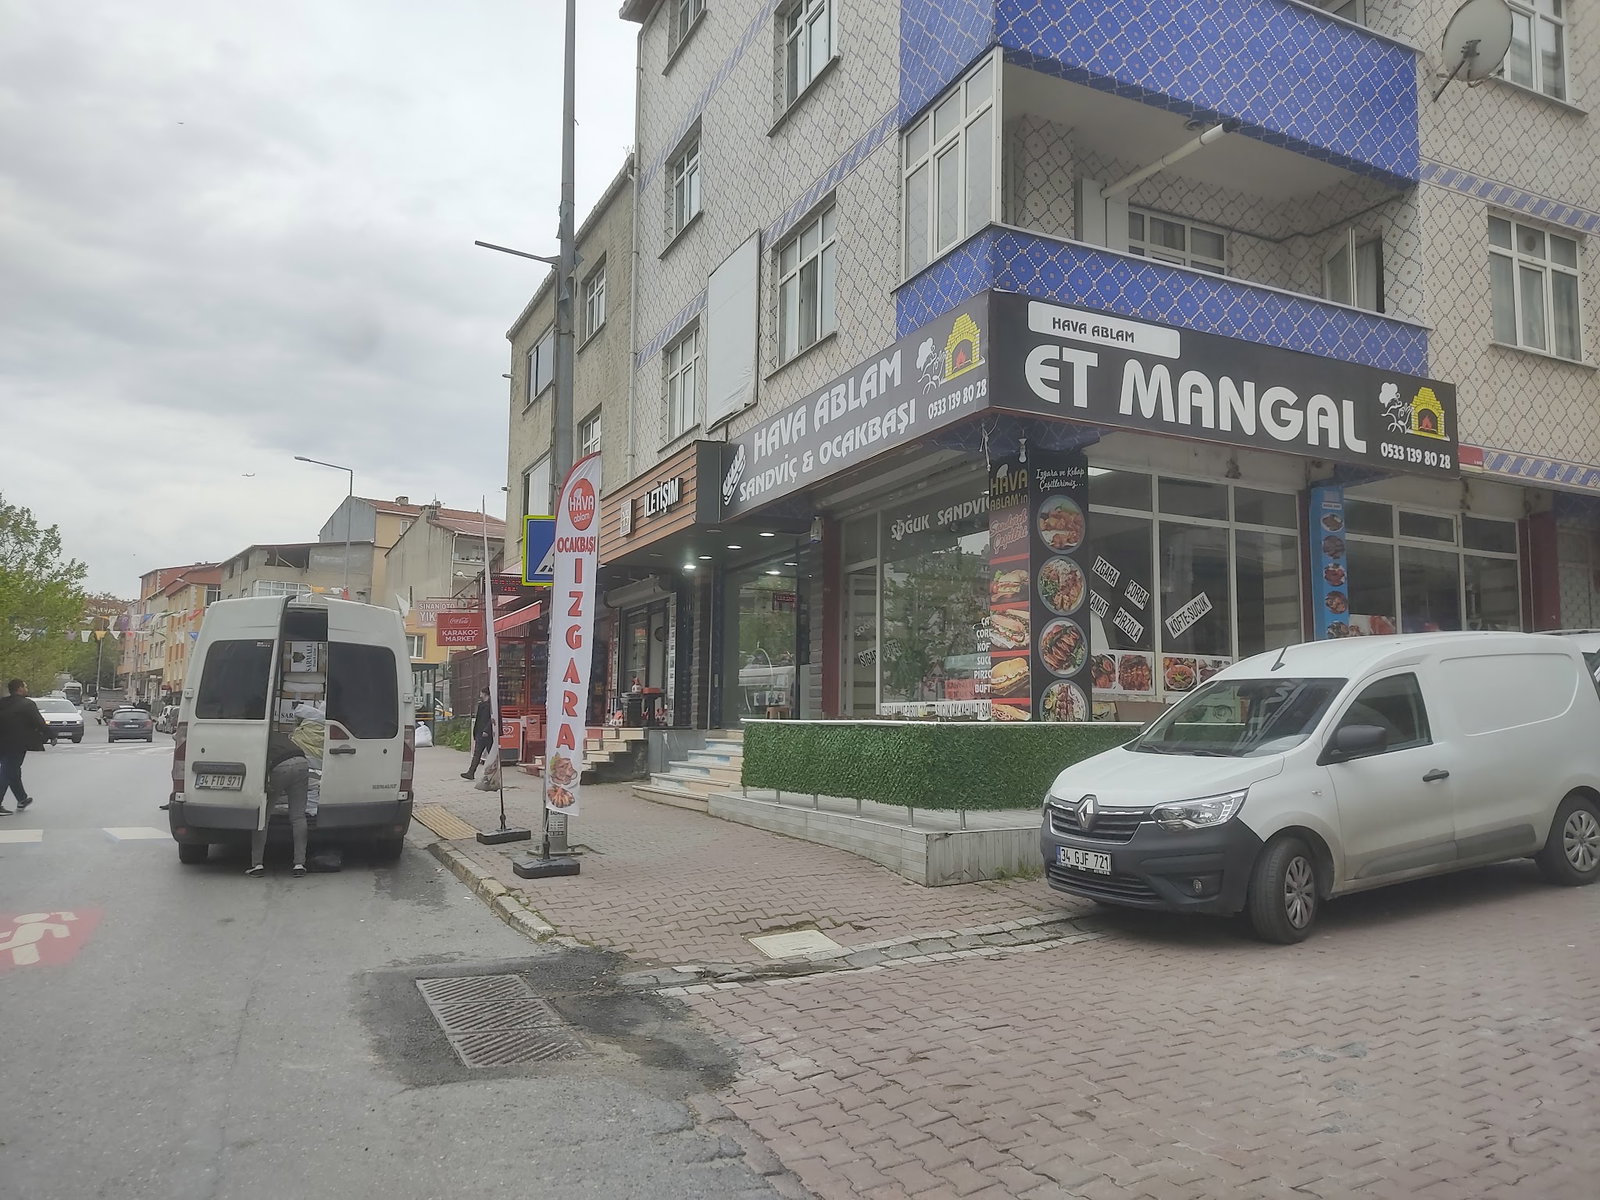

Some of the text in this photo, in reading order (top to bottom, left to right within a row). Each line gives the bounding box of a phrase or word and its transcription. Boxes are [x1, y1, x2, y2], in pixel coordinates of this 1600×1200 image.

[1052, 317, 1135, 344] HAVA ABLAM
[753, 349, 902, 465] HAVA ABLAM
[927, 378, 988, 420] 0533 139 80 28
[1024, 344, 1367, 454] ET MANGAL
[738, 397, 916, 503] SANDVİÇ & OCAKBAŞI
[1380, 441, 1451, 469] 0533 139 80 28
[989, 468, 1028, 497] HAVA
[569, 495, 595, 512] HAVA
[644, 476, 681, 518] İLETİŞİM
[556, 535, 597, 555] OCAKBAŞI
[1093, 558, 1119, 586] IZGARA
[200, 775, 209, 785] 34
[227, 776, 241, 786] 971
[1061, 848, 1071, 863] 34
[1074, 851, 1089, 866] GJF
[1094, 854, 1109, 870] 721
